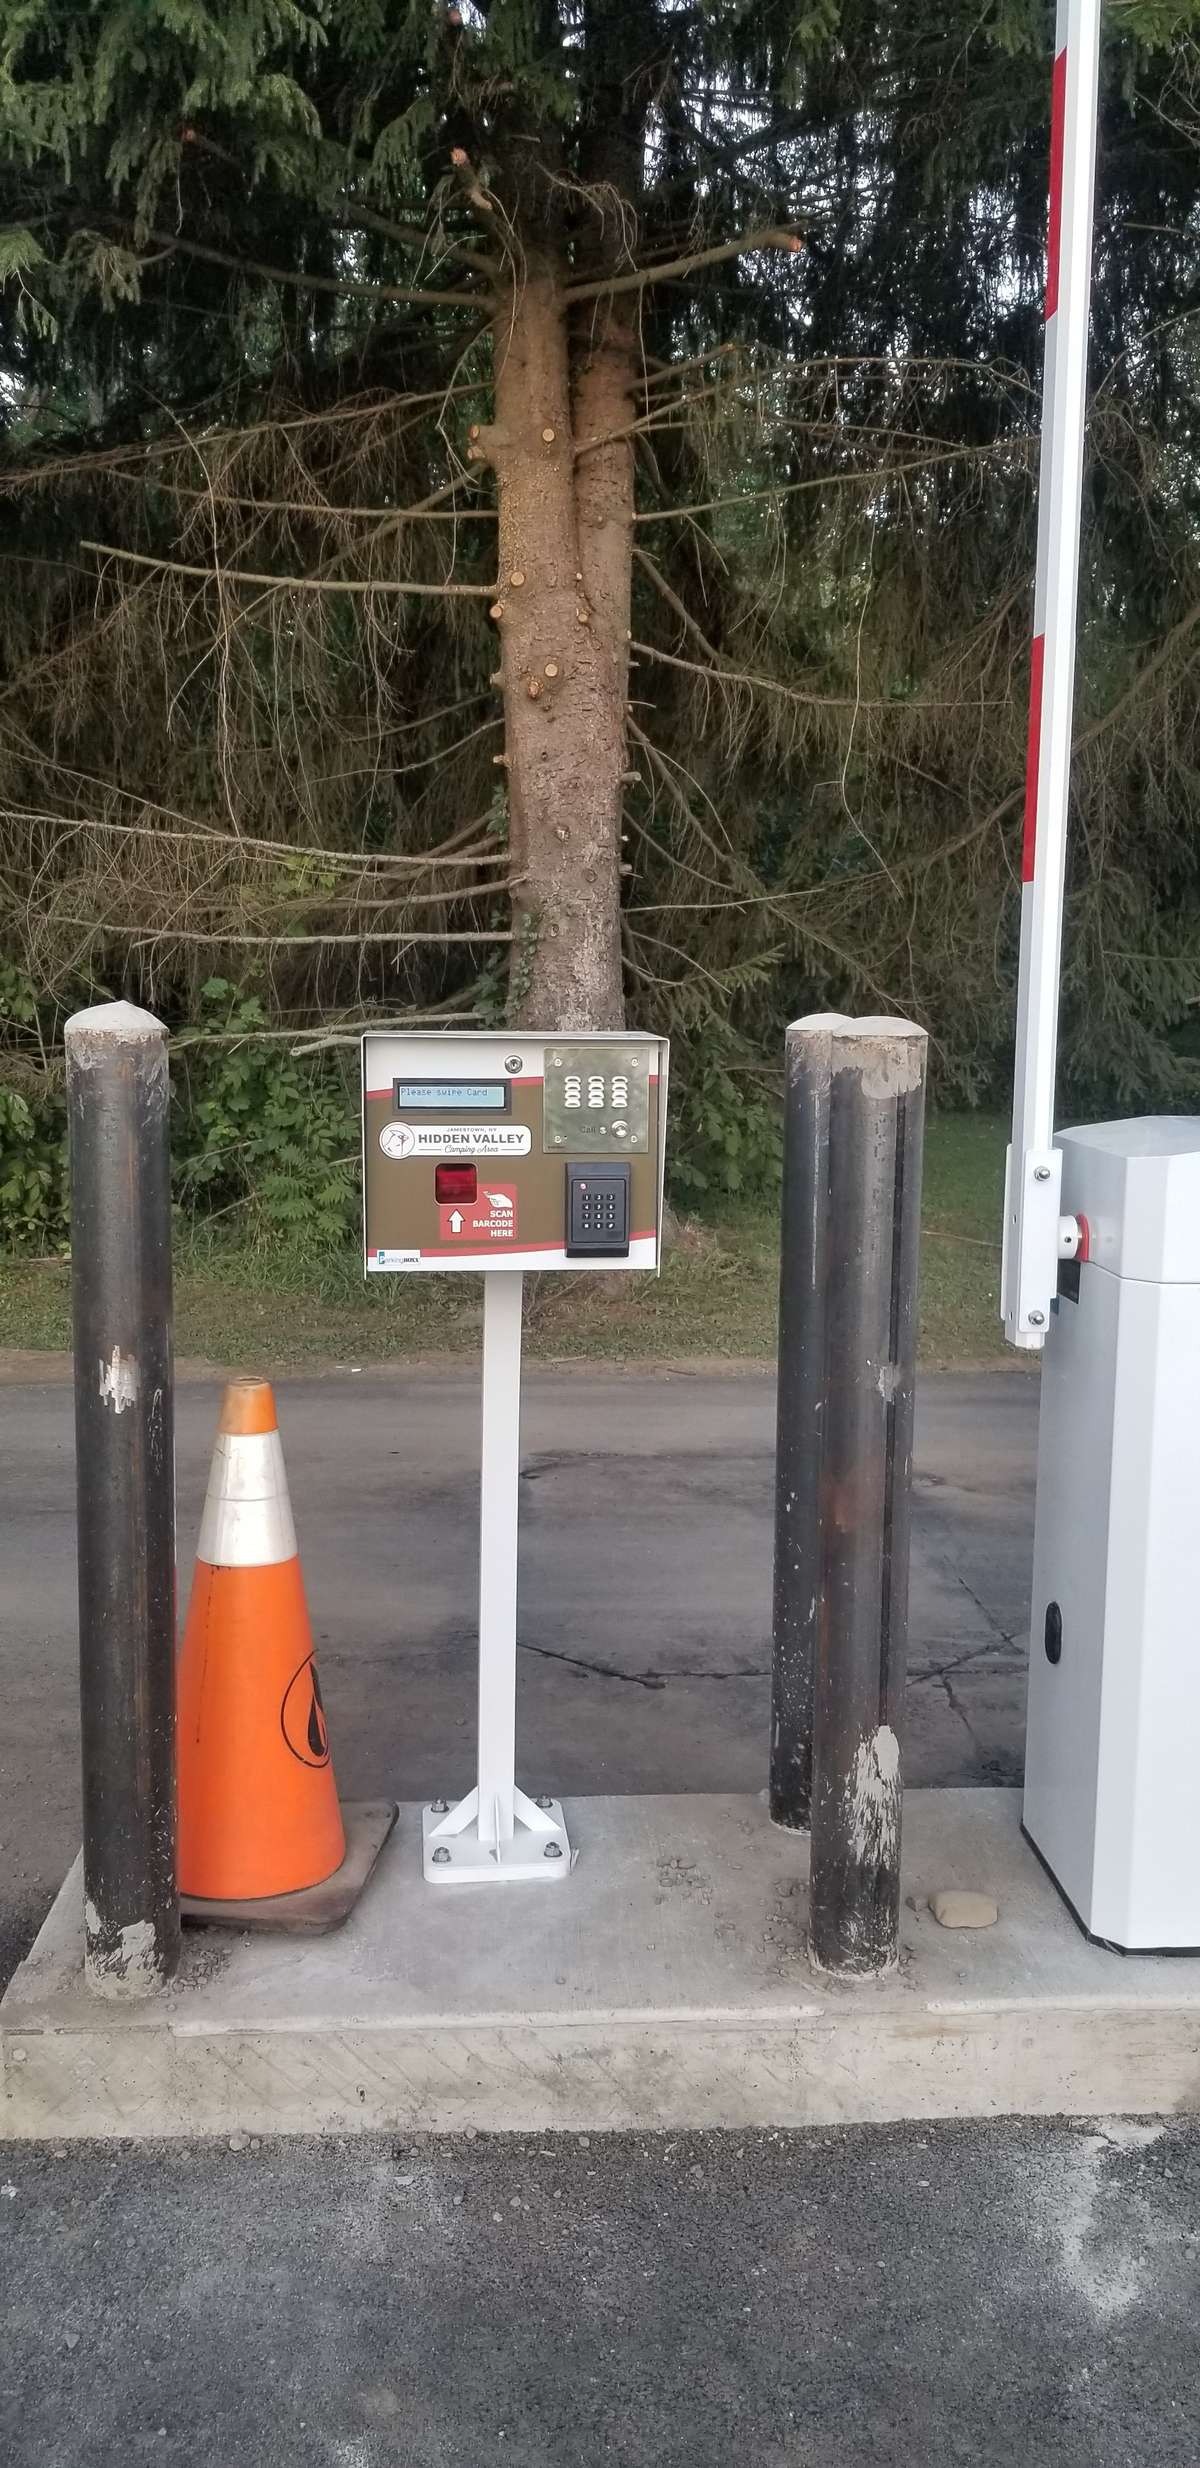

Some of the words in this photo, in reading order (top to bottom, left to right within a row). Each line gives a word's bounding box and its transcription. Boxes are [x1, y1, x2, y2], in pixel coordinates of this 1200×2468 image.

[400, 1088, 432, 1096] Please
[466, 1088, 488, 1096] Card
[418, 1134, 470, 1144] HIDDEN
[473, 1134, 524, 1144] VALLEY
[444, 1144, 476, 1155] Camping
[477, 1144, 499, 1153] Area
[490, 1210, 513, 1218] SCAN
[473, 1220, 513, 1228] BARCODE
[490, 1229, 513, 1237] HERE
